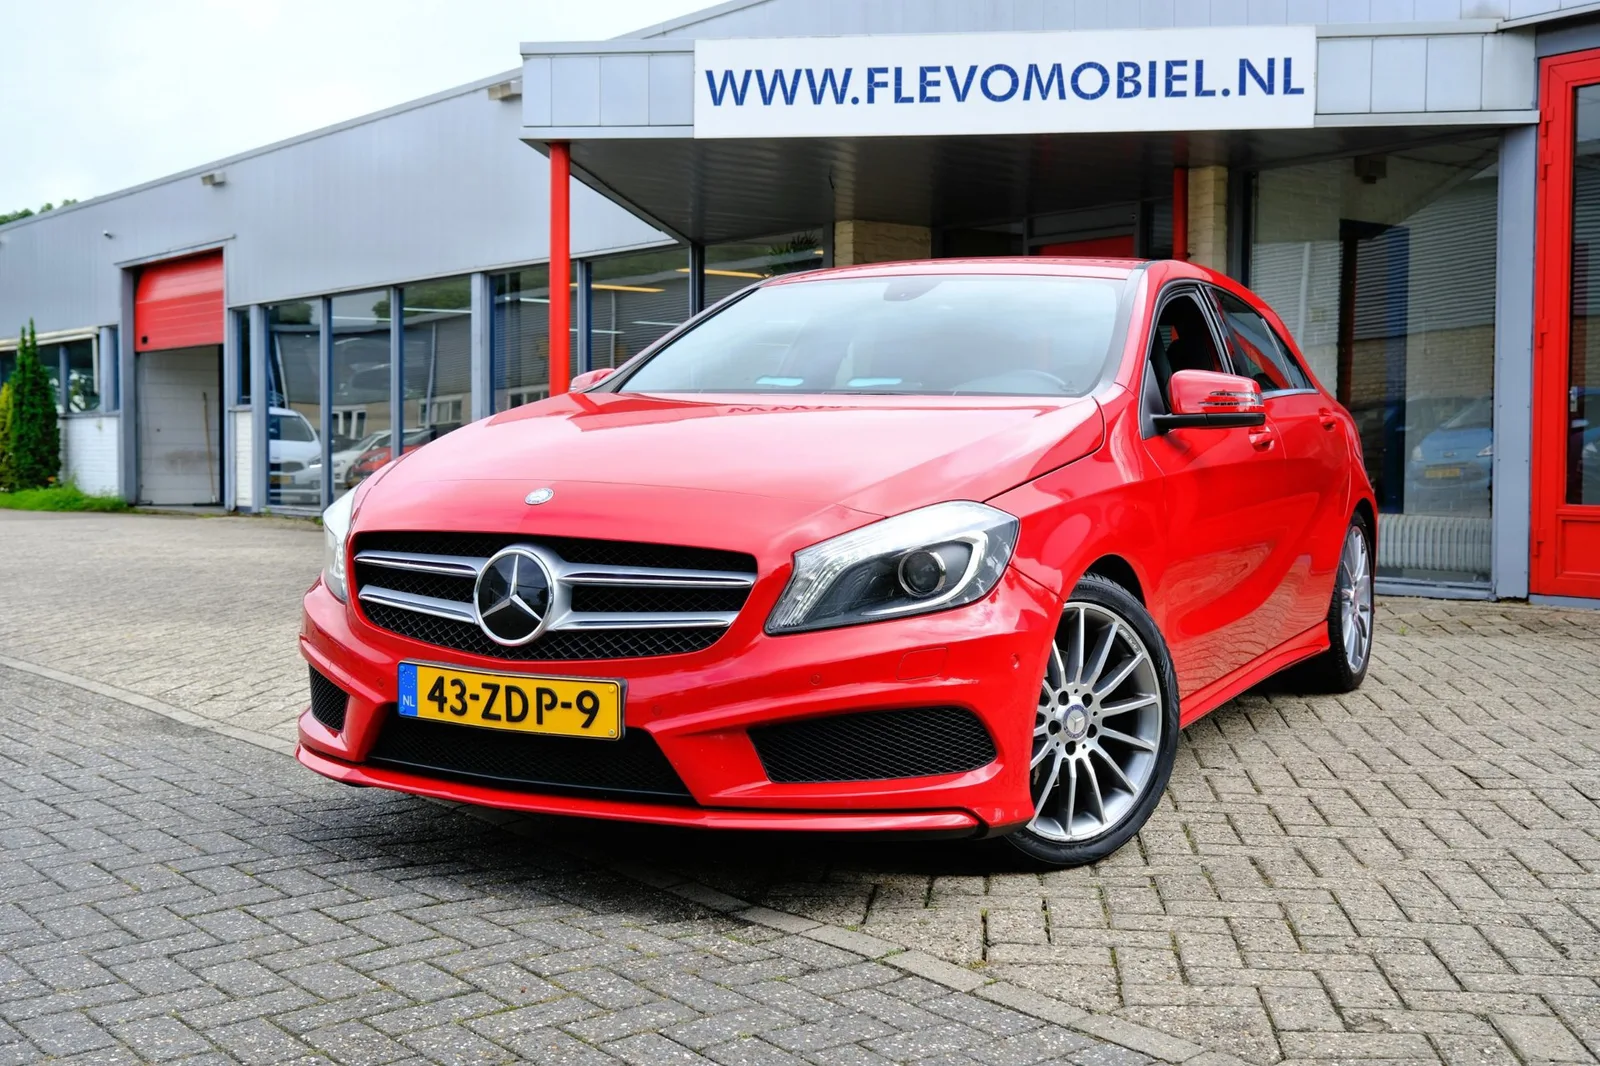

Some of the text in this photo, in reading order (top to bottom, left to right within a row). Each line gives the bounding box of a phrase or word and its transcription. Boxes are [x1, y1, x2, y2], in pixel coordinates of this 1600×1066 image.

[705, 57, 1304, 106] WWW.FLEVOMOBIEL.NL
[402, 694, 415, 708] NL
[427, 675, 600, 729] 43-ZDP-9
